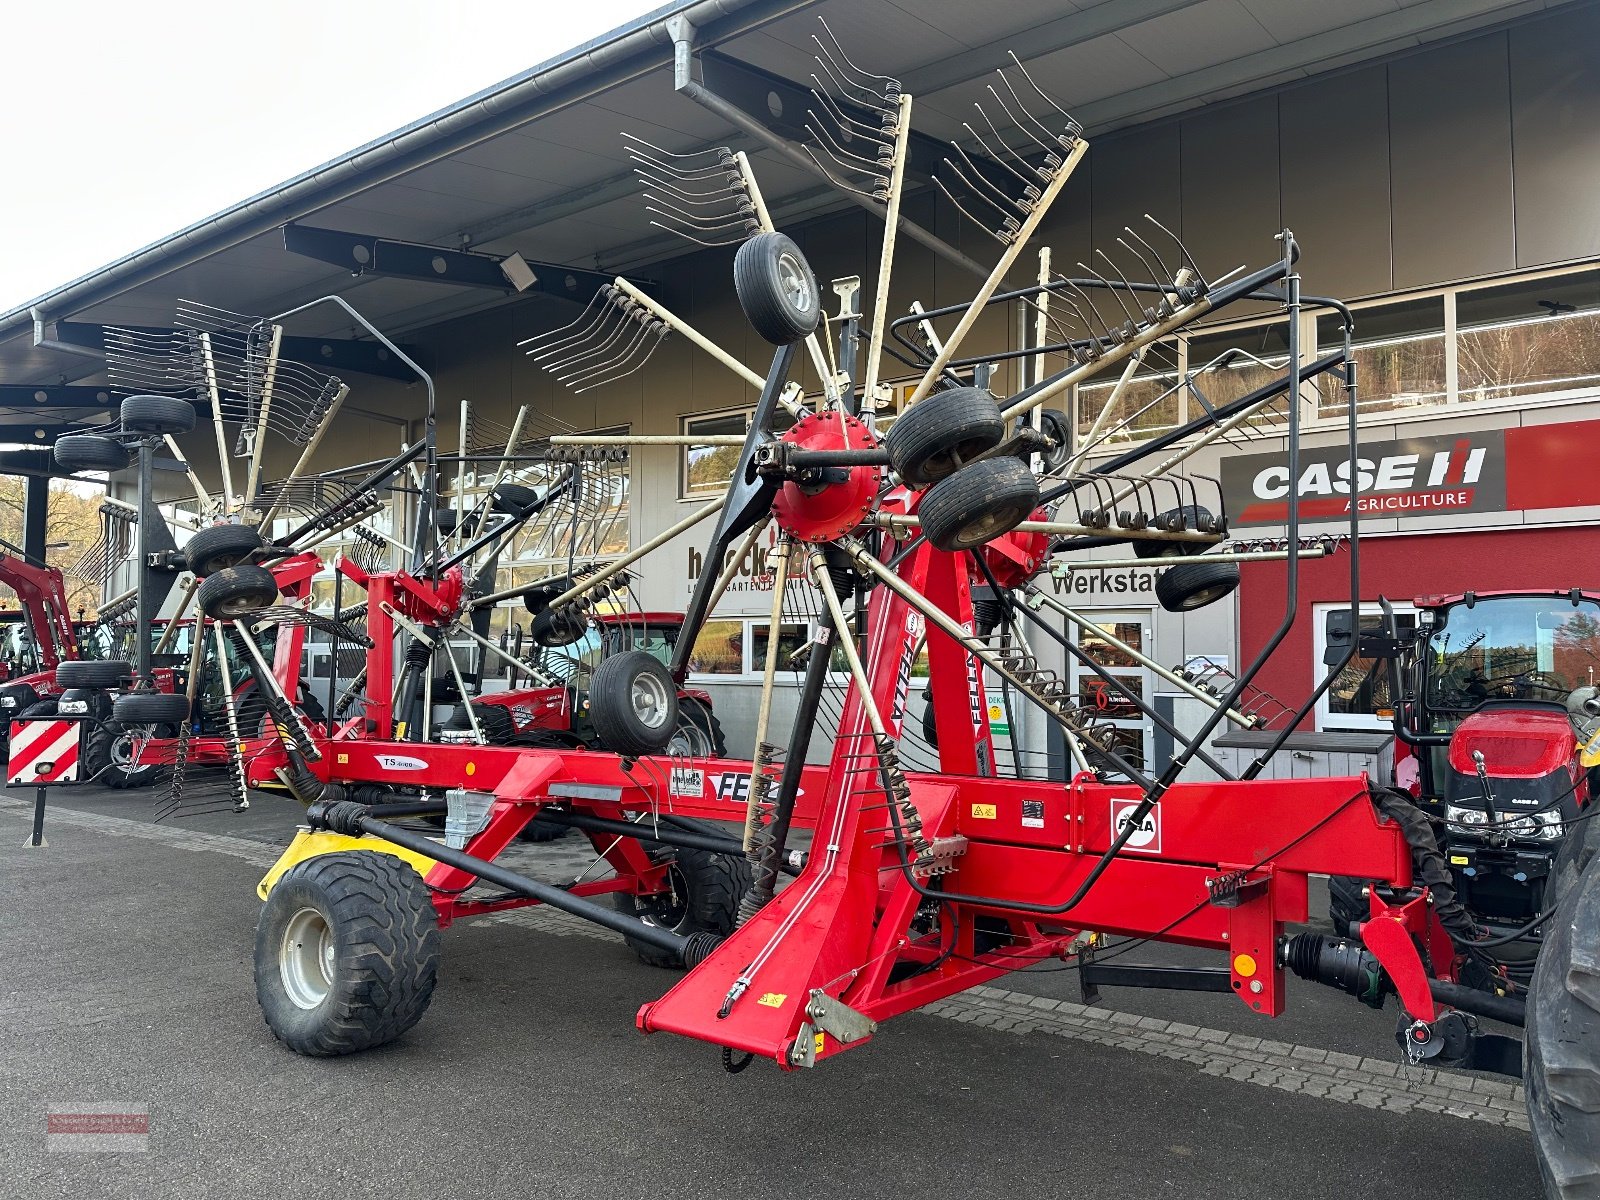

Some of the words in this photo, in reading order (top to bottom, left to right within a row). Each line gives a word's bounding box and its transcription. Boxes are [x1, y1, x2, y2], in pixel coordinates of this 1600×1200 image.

[1252, 454, 1419, 500] CASE
[1344, 492, 1467, 512] AGRICULTURE
[890, 639, 913, 720] FELLA
[966, 653, 982, 724] FELLA
[989, 696, 1004, 704] DEKR
[384, 758, 396, 766] TS
